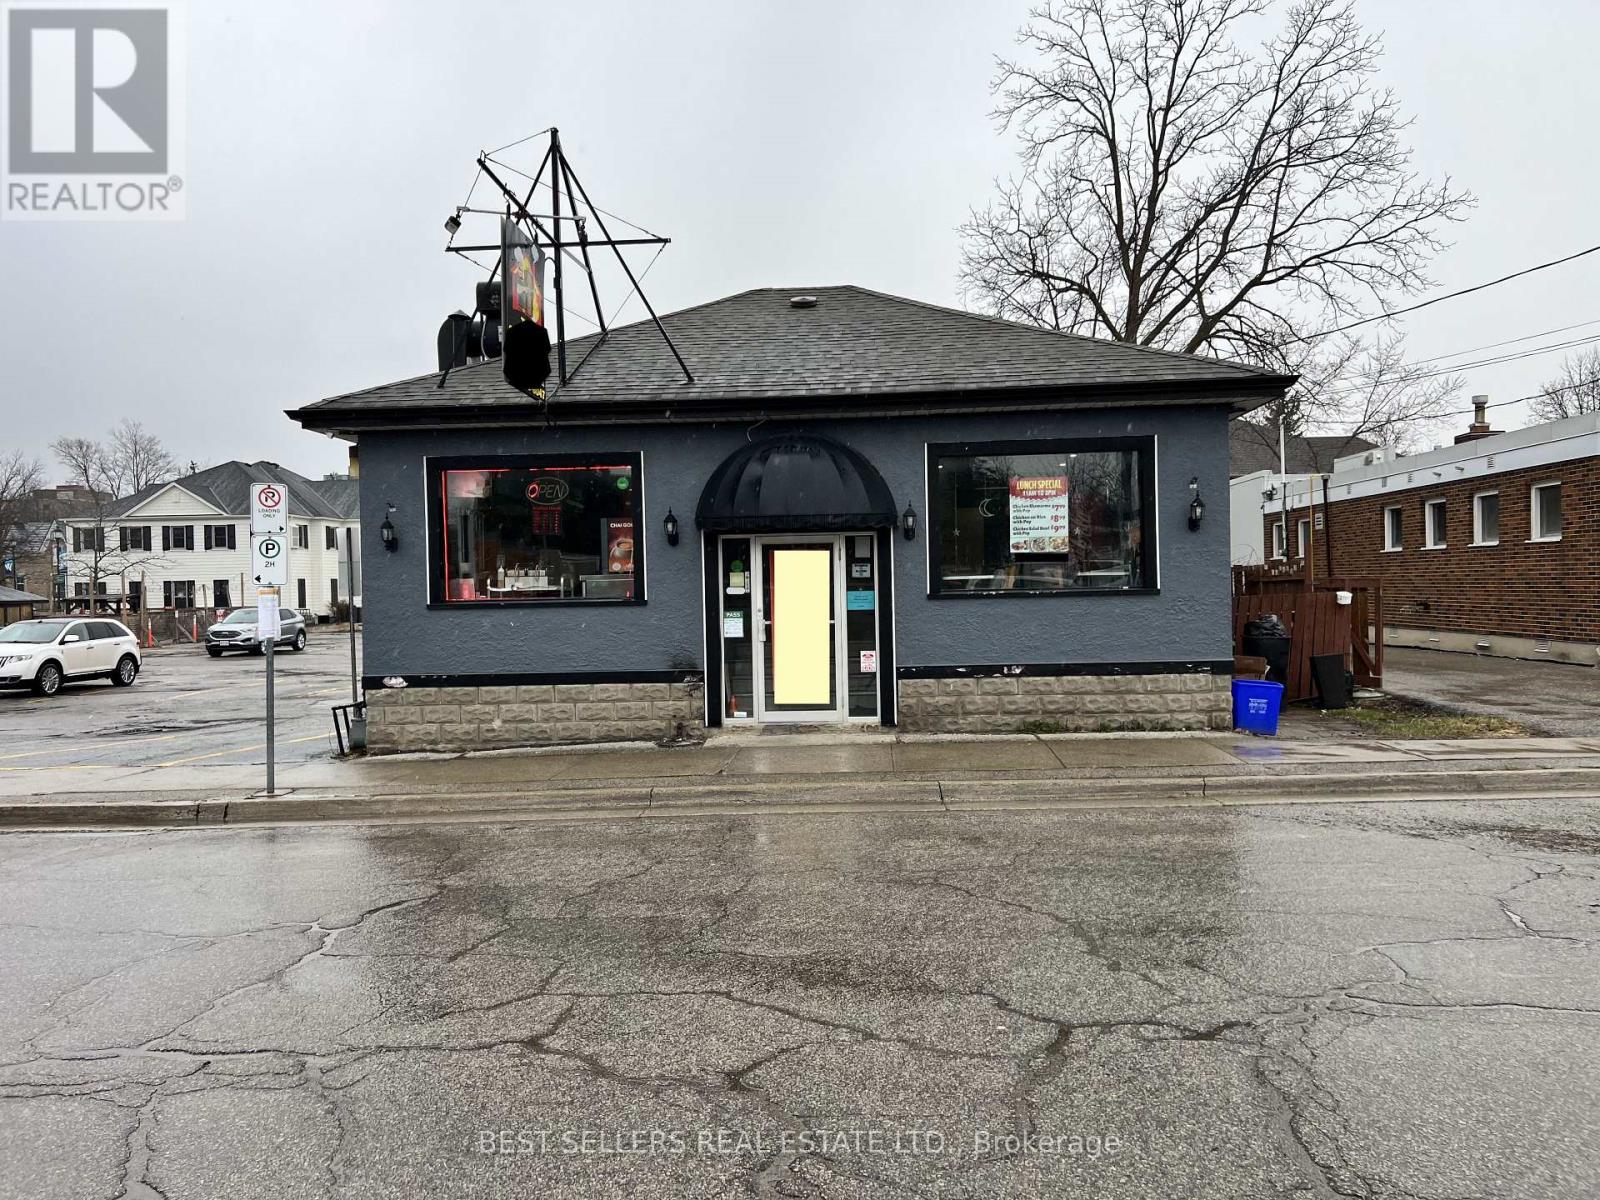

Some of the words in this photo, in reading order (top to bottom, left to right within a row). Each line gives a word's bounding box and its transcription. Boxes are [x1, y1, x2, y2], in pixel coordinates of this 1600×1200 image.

[1016, 480, 1037, 490] LUNCH
[1038, 479, 1062, 489] SPECIAL
[528, 484, 564, 498] OPEN
